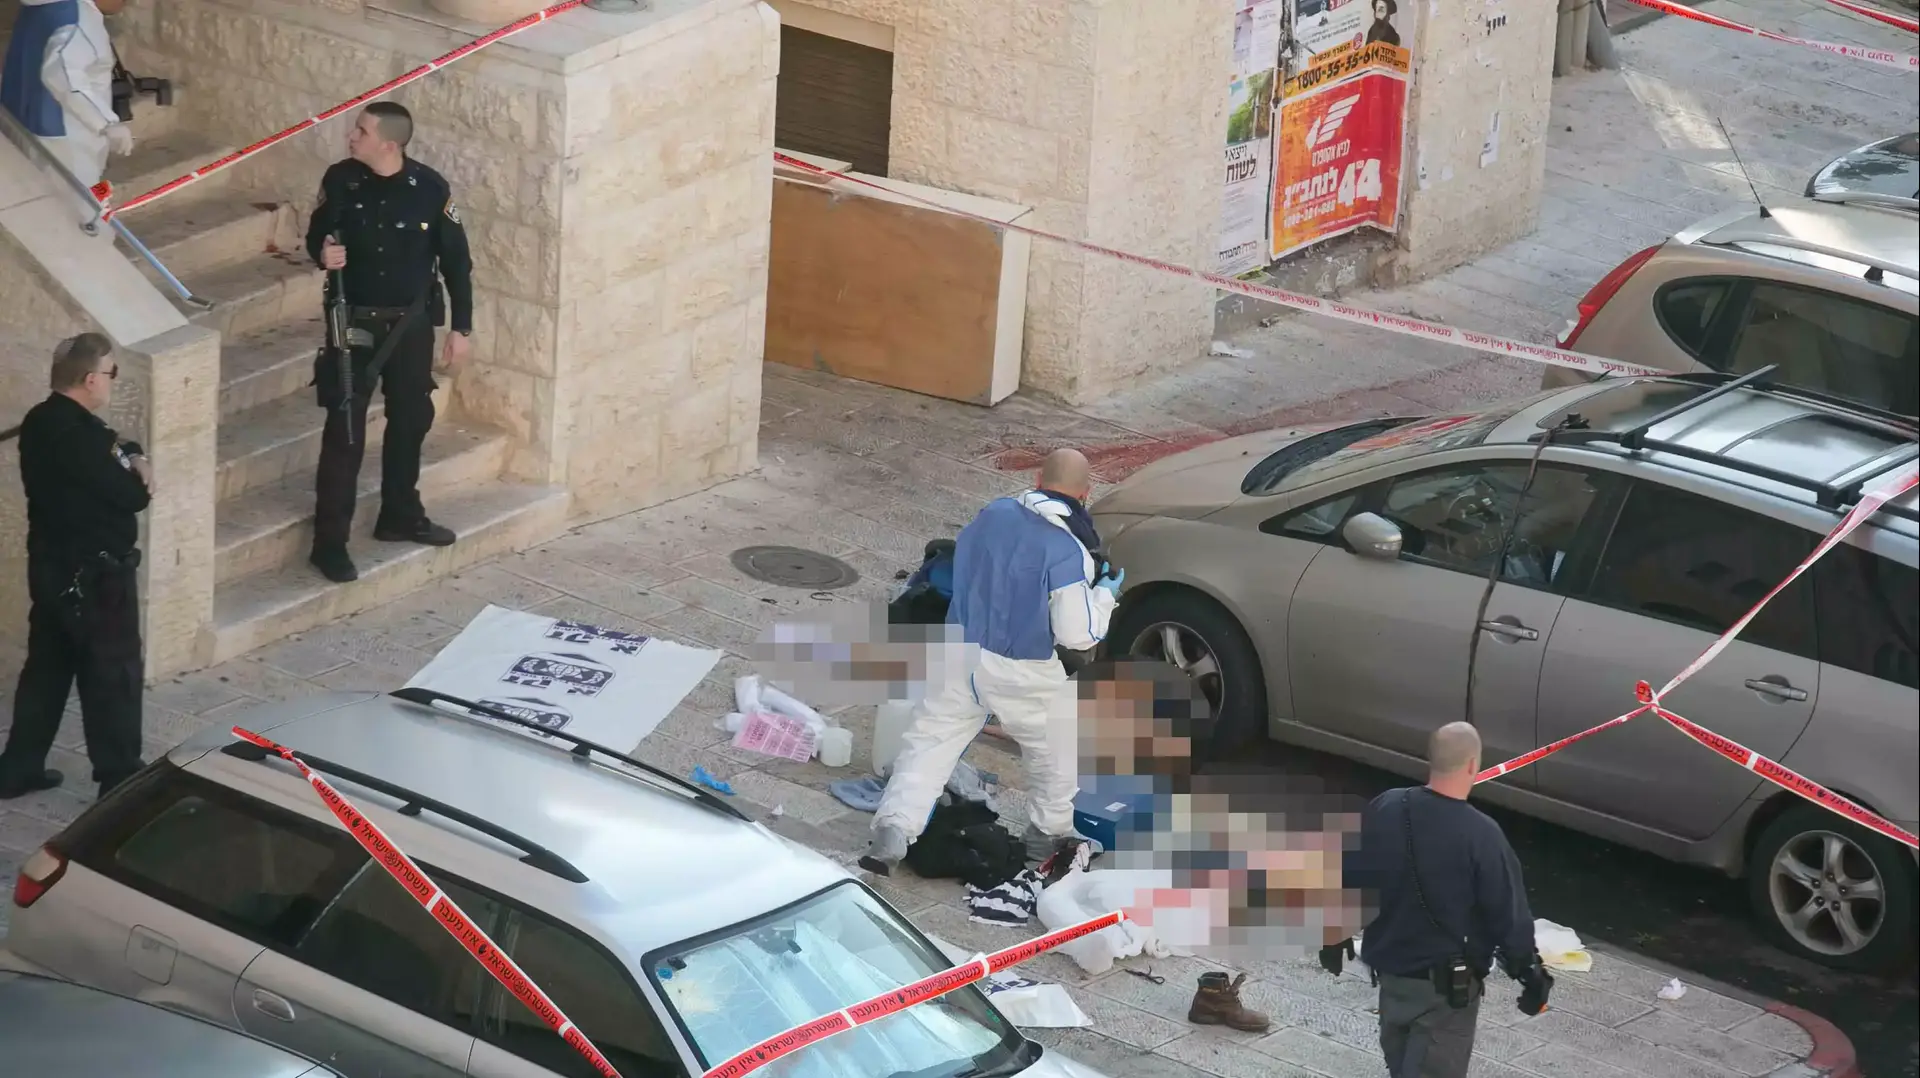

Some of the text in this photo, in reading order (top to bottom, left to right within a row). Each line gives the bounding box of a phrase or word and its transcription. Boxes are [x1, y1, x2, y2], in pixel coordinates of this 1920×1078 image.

[1226, 154, 1257, 183] לשוח
[1338, 158, 1382, 207] 44
[1287, 294, 1320, 307] משטרת
[1330, 304, 1452, 337] משטרת ישראל אין מעבר
[1463, 332, 1587, 365] משטרת ישראל אין מעבר
[1759, 759, 1793, 781] מעבר
[1796, 777, 1814, 792] אין
[337, 803, 354, 820] אין
[361, 823, 388, 852] ישראל
[396, 860, 430, 896] משטרת
[439, 902, 558, 1025] משטרת ישראל אין מעבר
[991, 953, 1017, 968] מעבר
[851, 965, 981, 1019] משטרת ישראל אין מעבר
[807, 1016, 843, 1037] משטרת
[567, 1031, 593, 1059] מעבר
[764, 1034, 795, 1055] ישראל
[738, 1055, 755, 1070] אין
